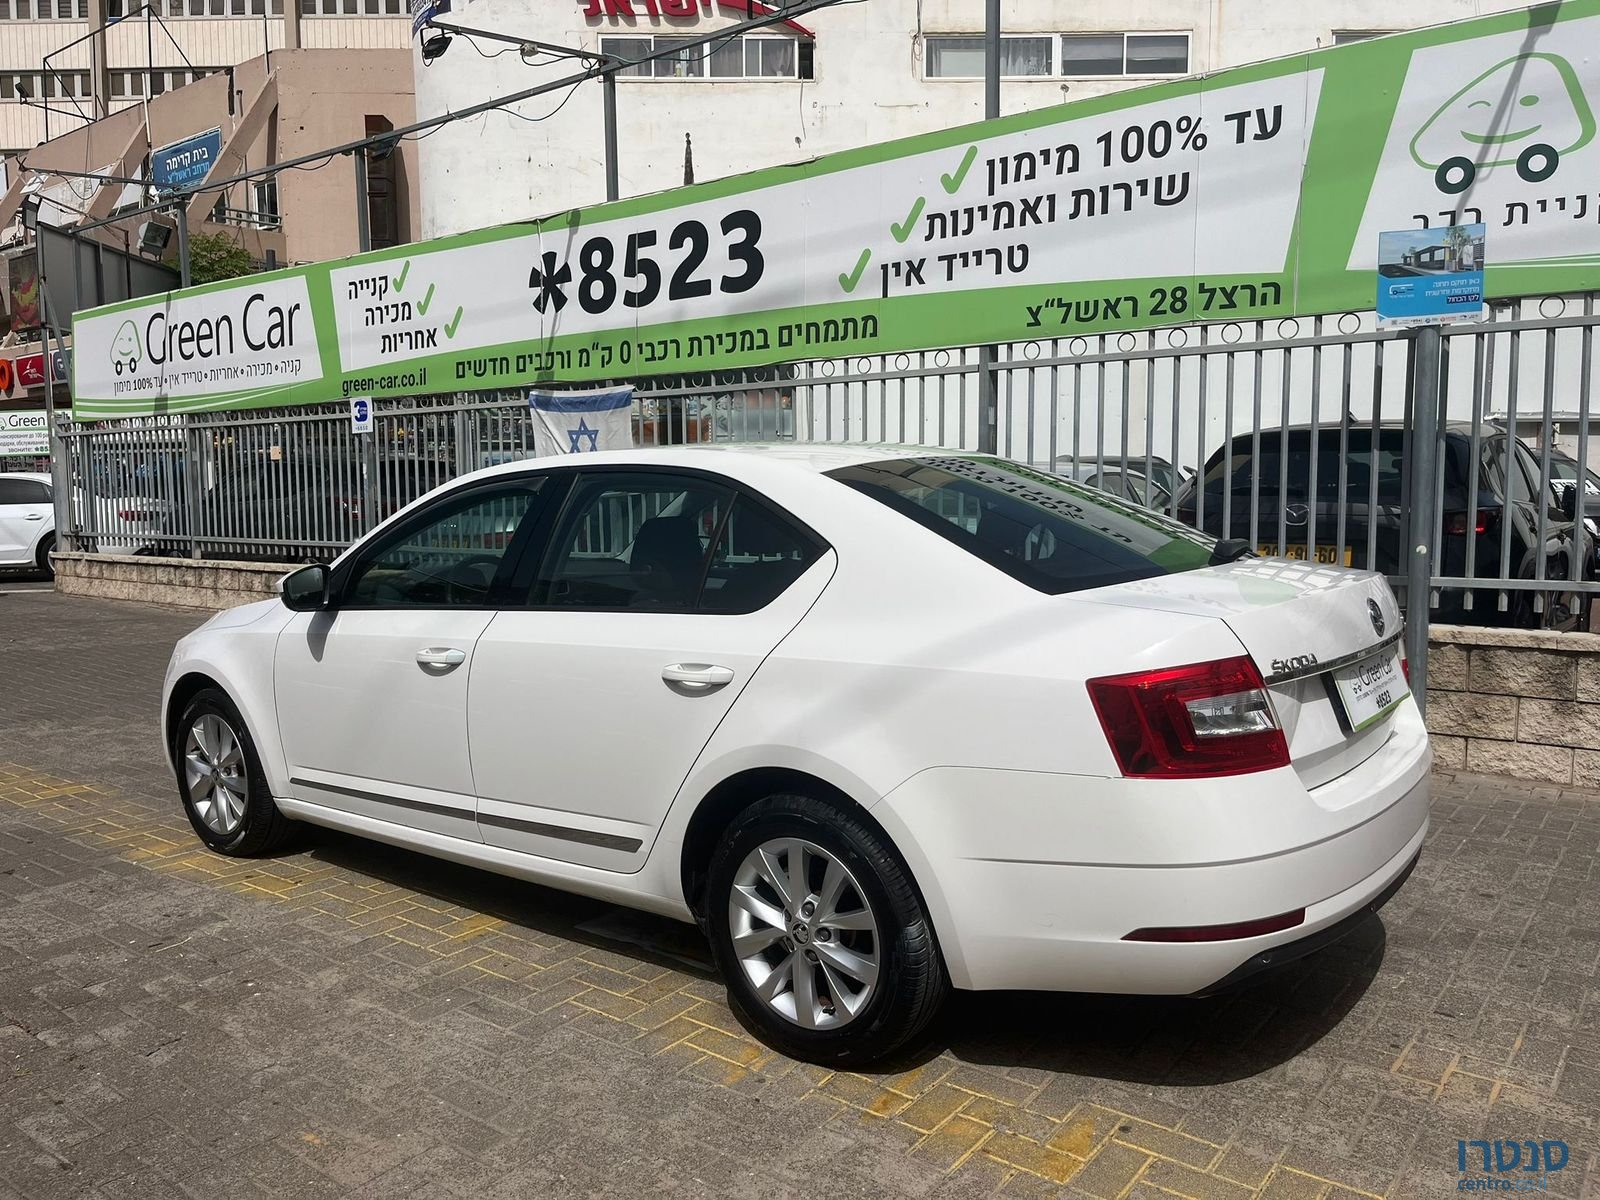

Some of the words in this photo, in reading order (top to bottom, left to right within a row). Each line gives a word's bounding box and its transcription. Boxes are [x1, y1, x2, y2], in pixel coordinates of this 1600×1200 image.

[1224, 104, 1283, 144] עד
[193, 147, 209, 161] בית
[1096, 115, 1208, 167] 100%
[986, 143, 1080, 196] מימון
[1068, 171, 1190, 220] שירות
[924, 195, 1056, 242] ואמינות
[1503, 193, 1600, 226] ניית
[937, 242, 1030, 281] טרייד
[348, 275, 389, 301] קנייה
[880, 258, 926, 298] אין
[1149, 286, 1188, 316] 28
[1198, 281, 1281, 311] הרצל
[365, 301, 412, 326] מכירה
[1026, 296, 1138, 328] ראשל"צ
[146, 312, 234, 365] Green
[242, 293, 300, 351] Car
[381, 327, 438, 353] אחריות
[778, 314, 879, 347] מתמחים
[578, 342, 613, 368] ק"מ
[619, 340, 631, 364] 0
[637, 338, 681, 362] רכבי
[687, 328, 770, 357] במכירת
[210, 366, 239, 381] אחריות
[246, 362, 272, 377] מכירה
[281, 359, 301, 376] קניה
[455, 357, 510, 379] חדשים
[516, 350, 571, 373] ורכבים
[114, 380, 131, 396] מימון
[133, 377, 153, 391] 100%
[168, 374, 180, 389] אין
[182, 370, 203, 385] טרייד
[342, 367, 427, 396] green-car.co.il
[8, 414, 46, 428] Green
[1271, 653, 1318, 675] ŠKODA
[1358, 661, 1384, 686] Green
